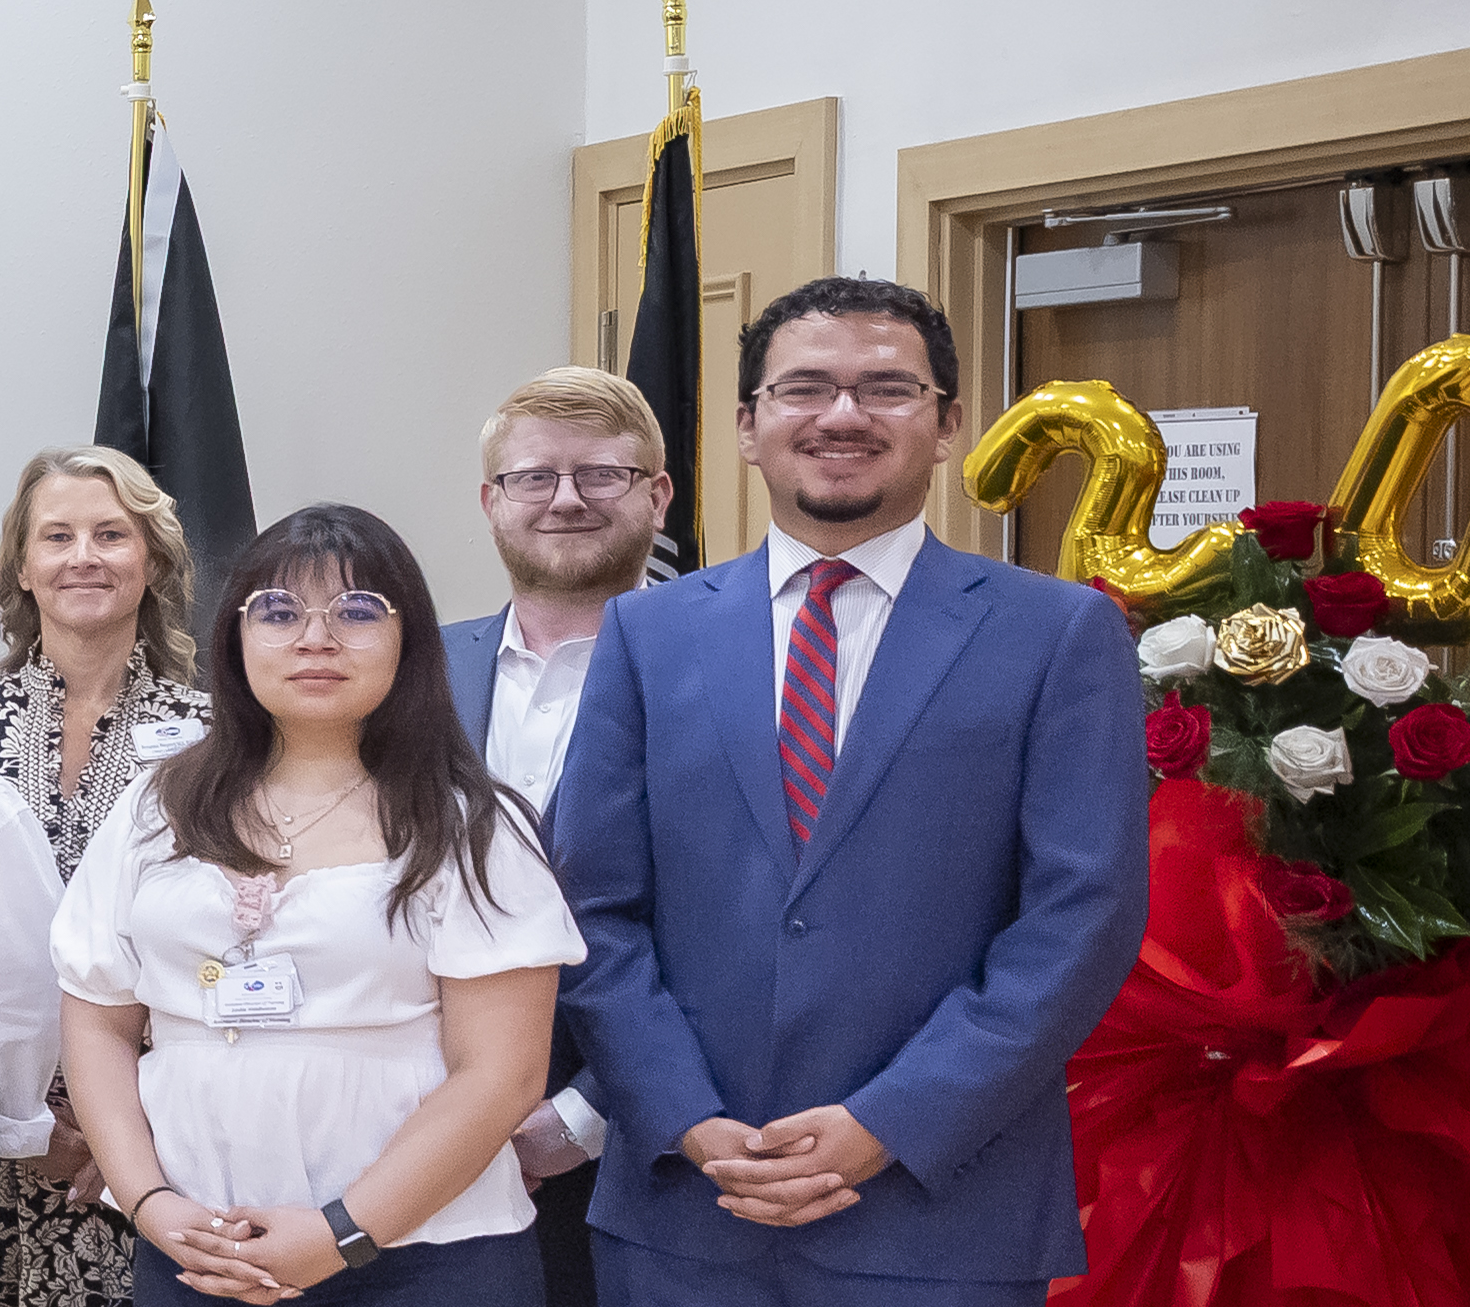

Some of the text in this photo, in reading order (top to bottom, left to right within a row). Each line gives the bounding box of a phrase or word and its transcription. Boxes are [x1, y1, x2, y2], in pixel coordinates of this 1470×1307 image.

[1166, 443, 1241, 458] OU ARE USING
[1191, 467, 1225, 480] ROOM,
[1157, 489, 1241, 503] EASE CLEAN UP
[1152, 514, 1179, 526] FTER
